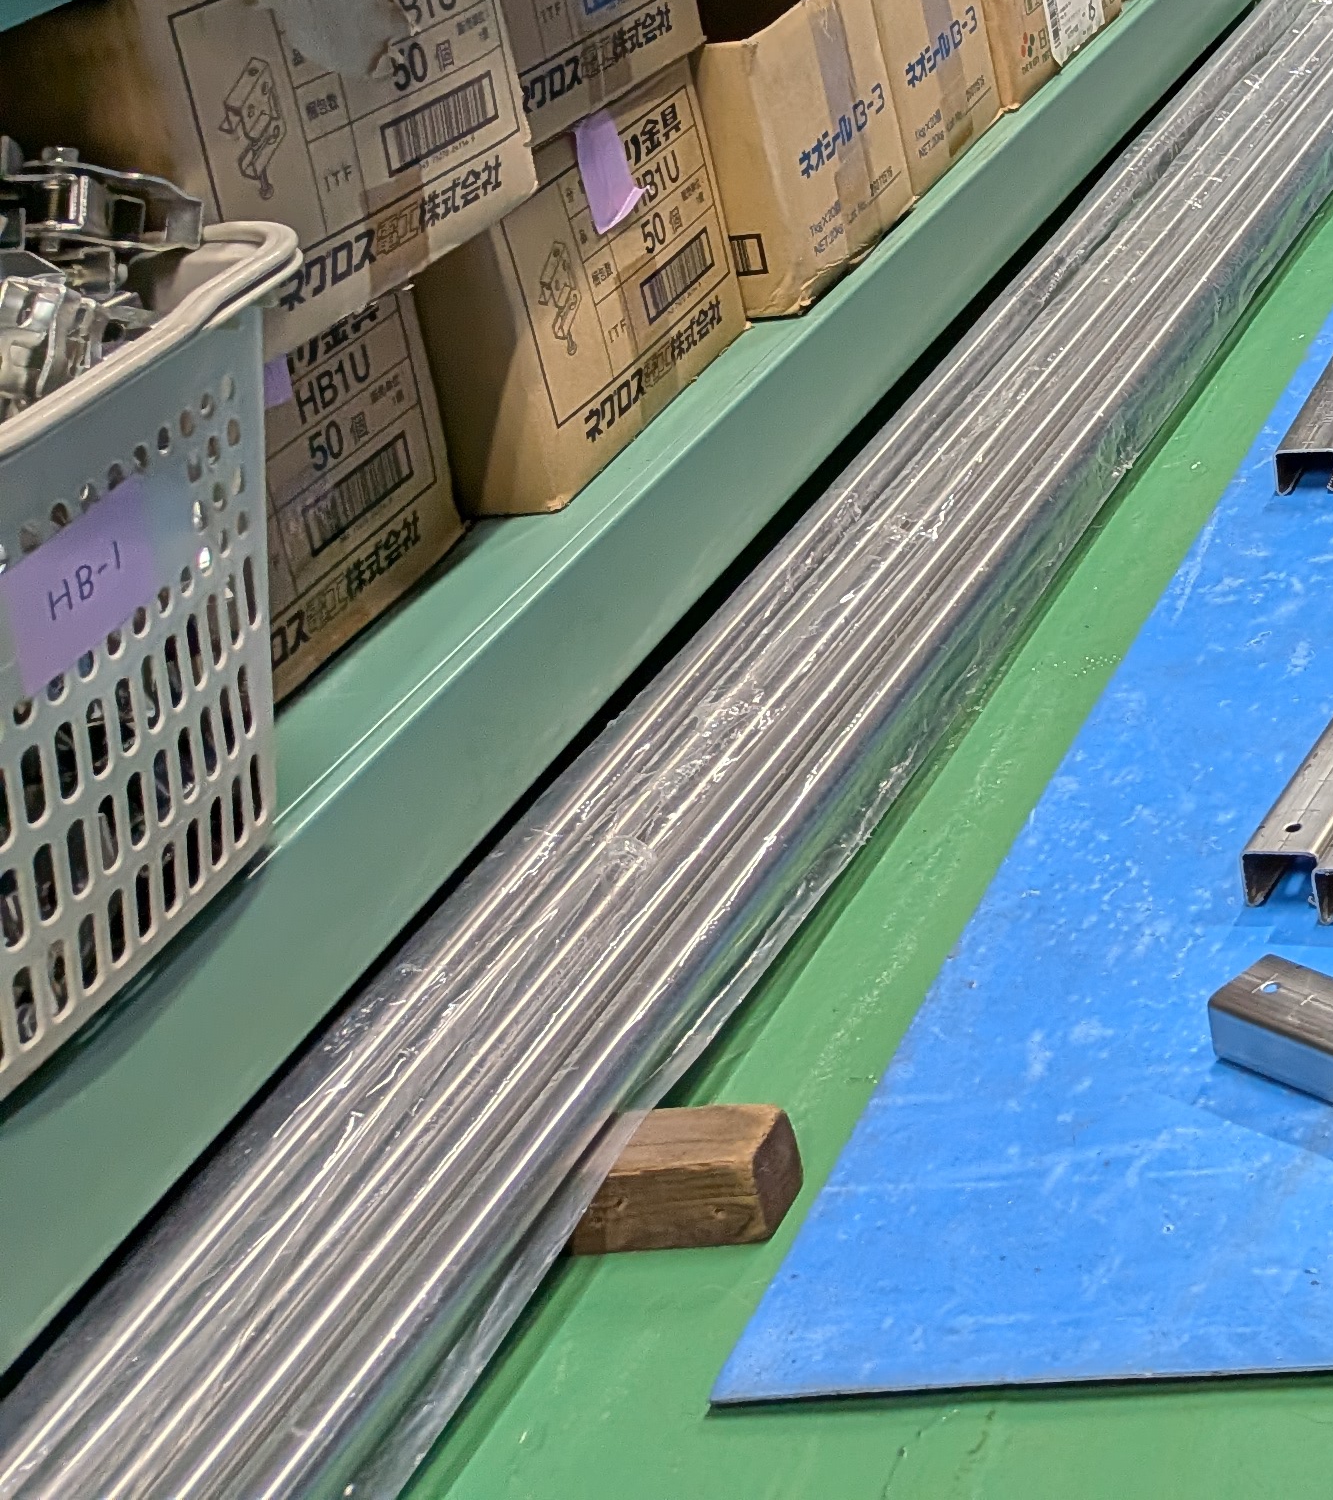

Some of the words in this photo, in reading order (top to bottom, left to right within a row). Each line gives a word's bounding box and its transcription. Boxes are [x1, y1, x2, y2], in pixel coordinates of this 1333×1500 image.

[391, 41, 428, 92] 50
[622, 102, 683, 167] り金具
[324, 163, 353, 193] ITF
[640, 211, 667, 254] 50
[607, 317, 628, 344] ITF
[295, 343, 371, 425] HB1U
[308, 420, 344, 473] 50
[48, 541, 122, 623] HB-1
[270, 509, 422, 675] ロス電工株式会社
